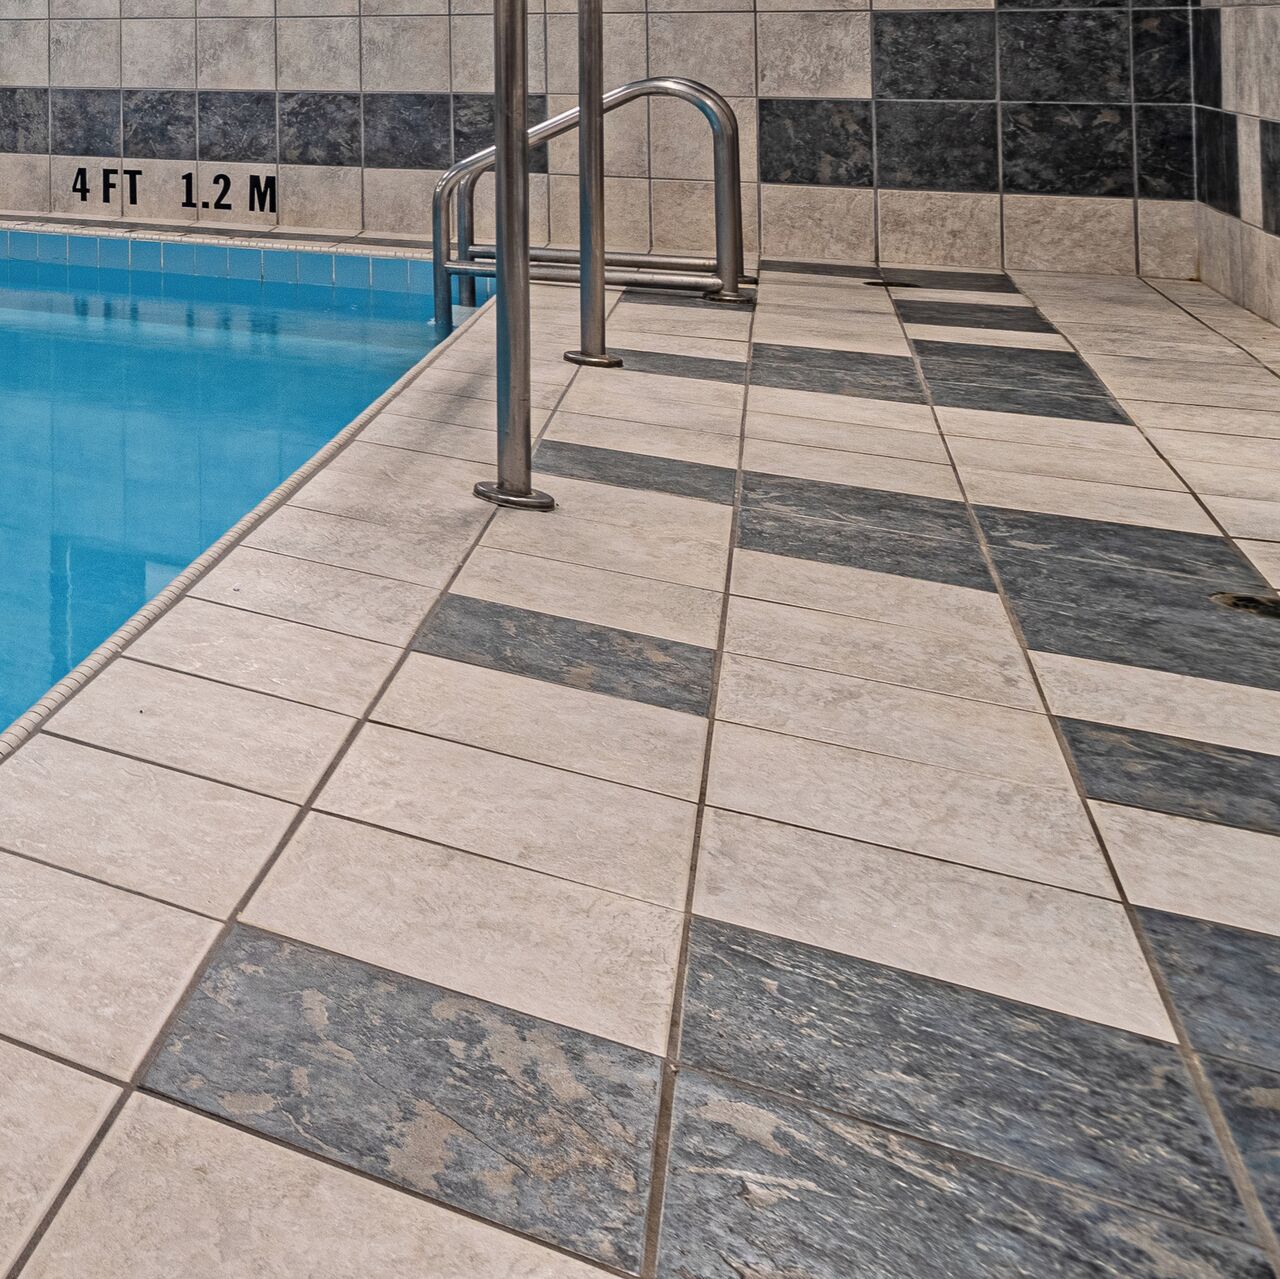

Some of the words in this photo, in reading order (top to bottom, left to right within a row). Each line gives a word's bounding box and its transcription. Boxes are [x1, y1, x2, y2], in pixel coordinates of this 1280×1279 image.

[72, 168, 90, 202] 4
[102, 168, 142, 205] FT
[181, 172, 232, 210] 1.2
[249, 174, 277, 213] M
